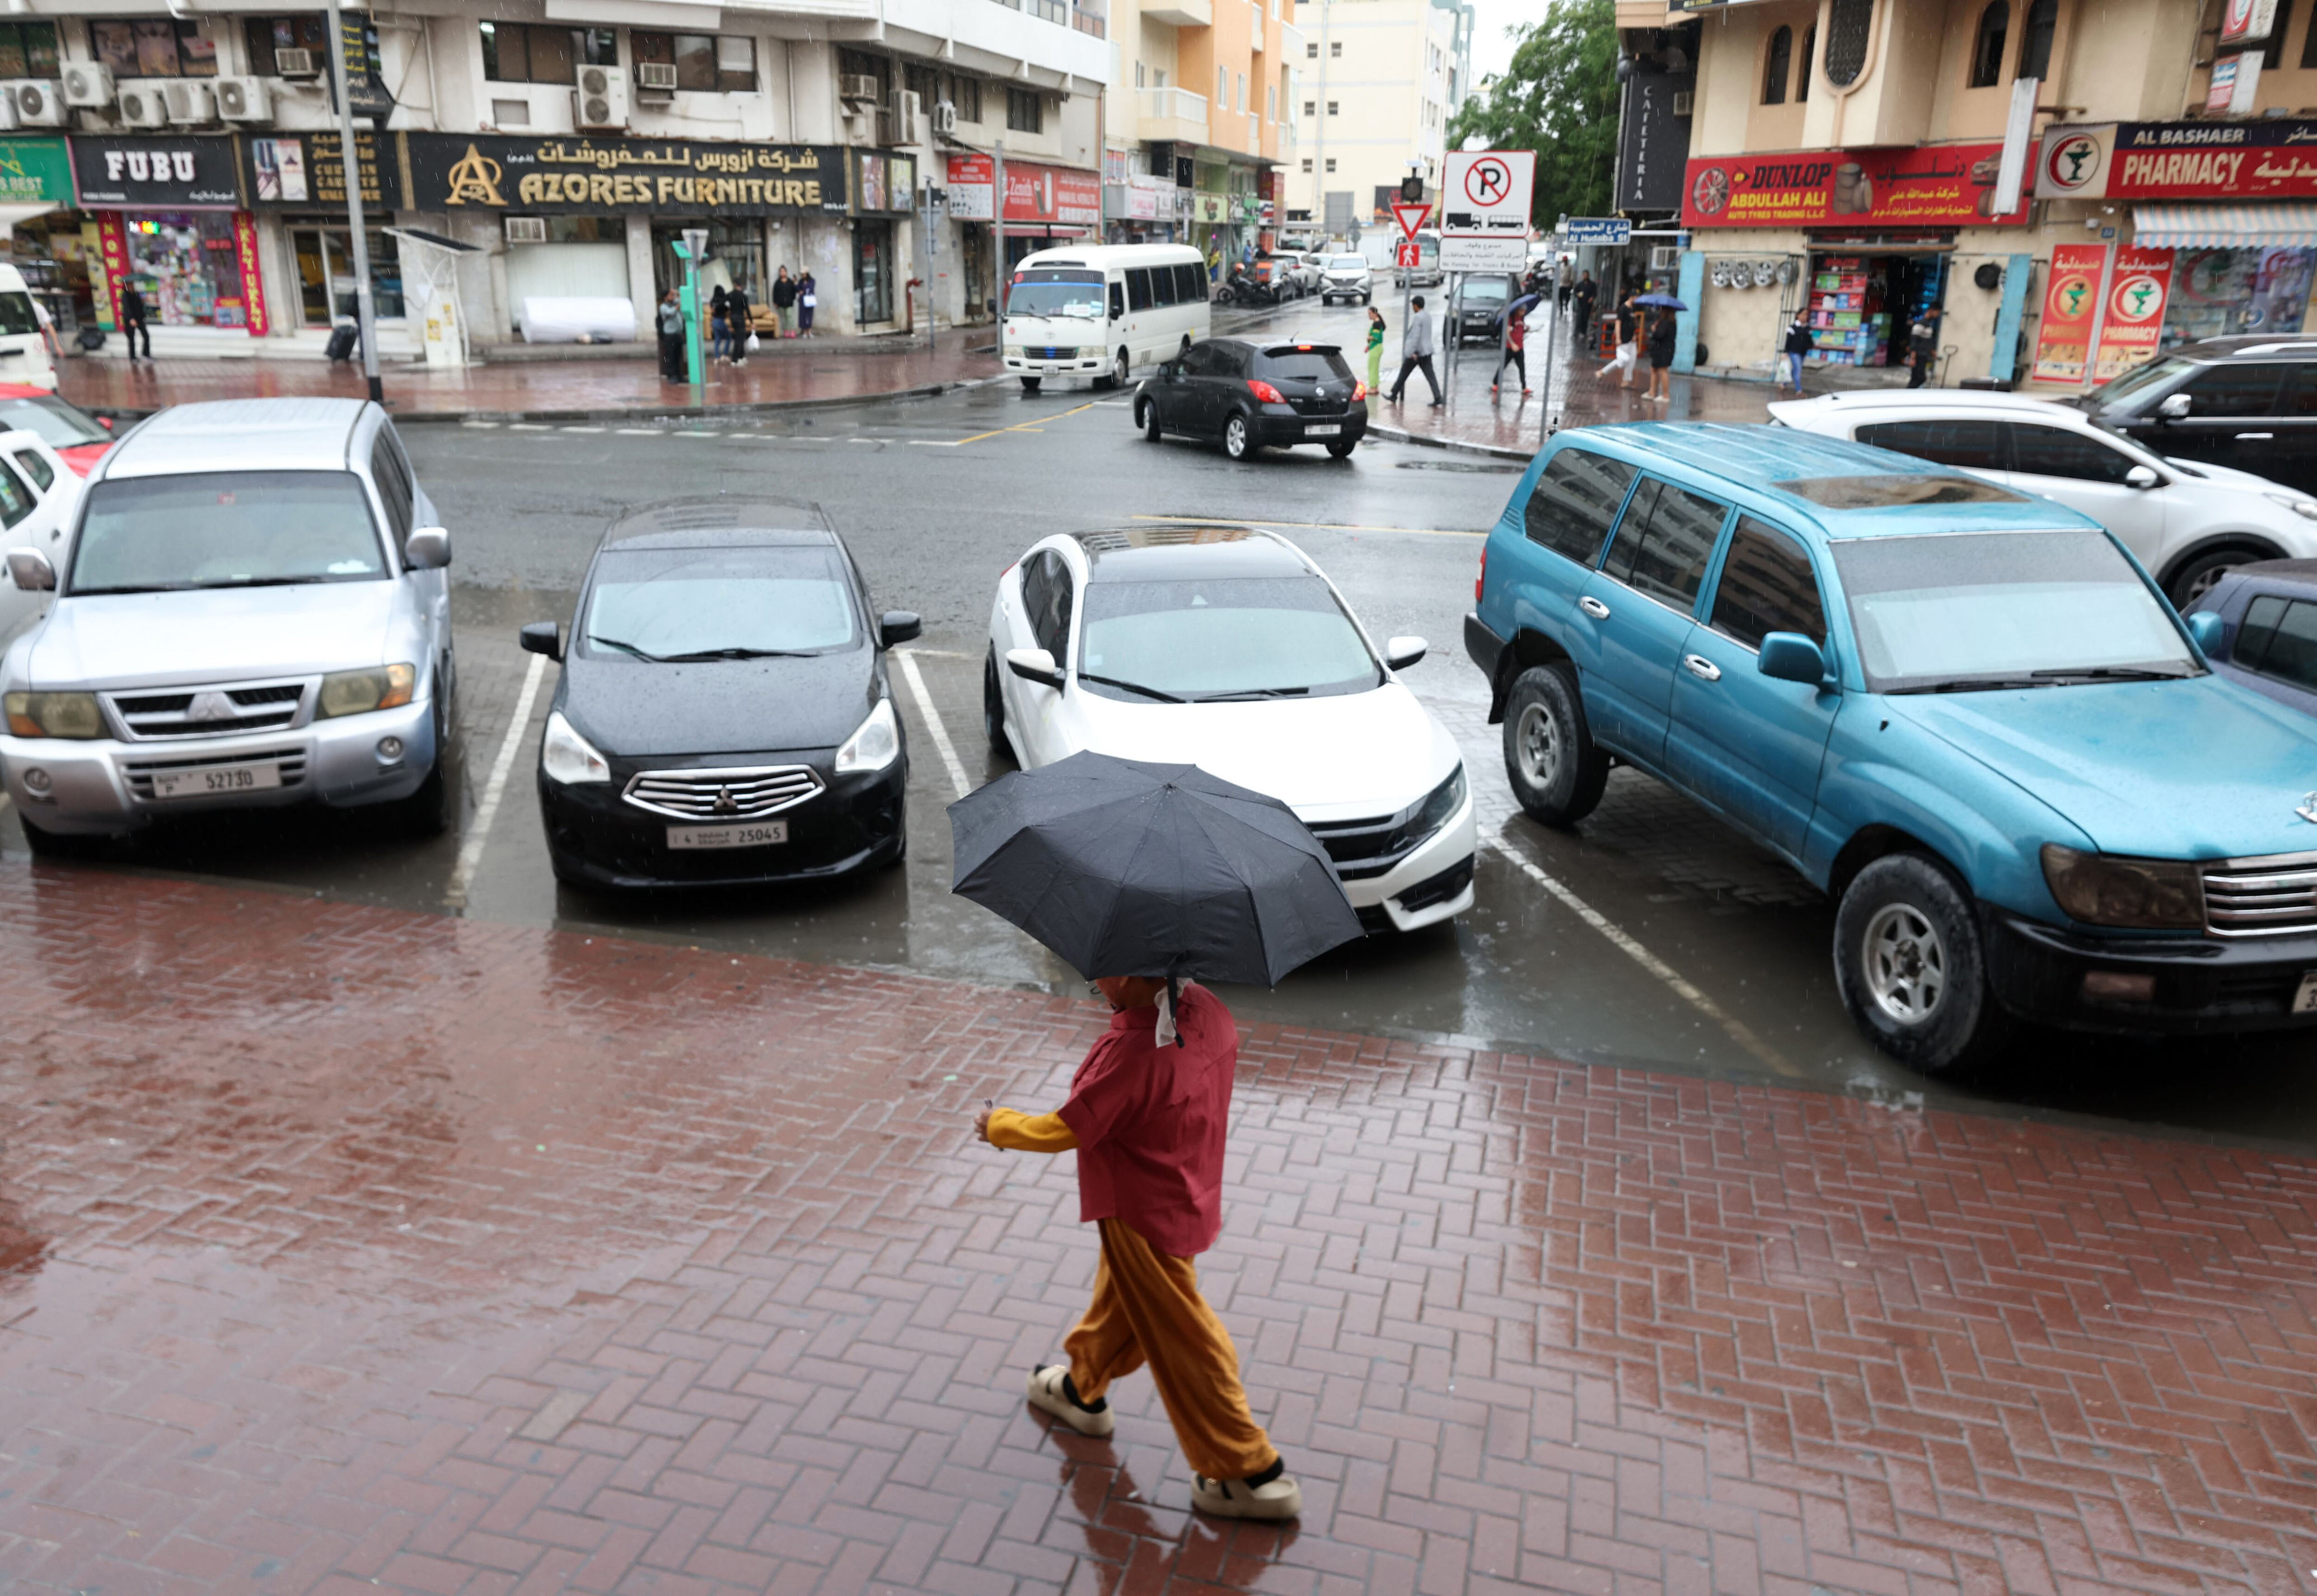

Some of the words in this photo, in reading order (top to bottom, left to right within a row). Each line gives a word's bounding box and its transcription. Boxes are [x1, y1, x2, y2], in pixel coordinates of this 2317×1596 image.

[1633, 86, 1653, 201] CAFETERIA
[2133, 129, 2157, 146] AL
[2159, 128, 2246, 145] BASHAER
[537, 139, 691, 170] للمفروشات
[695, 148, 753, 173] ازورس
[757, 147, 818, 174] شركة
[105, 151, 195, 181] FUBU
[1750, 163, 1833, 188] DUNLOP
[1876, 155, 1967, 188] دنلوب
[2121, 152, 2245, 185] PHARMACY
[519, 173, 653, 206] AZORES
[656, 176, 822, 207] FURNITURE
[1009, 176, 1033, 196] Zenith
[1480, 168, 1501, 196] P
[1729, 193, 1801, 208] ABDULLAH
[1803, 191, 1827, 207] ALI
[1936, 185, 1960, 200] شركة
[1727, 210, 1747, 219] AUTO
[1748, 210, 1771, 219] TYRES
[1772, 209, 1805, 219] TRADING
[1569, 233, 1578, 242] Al
[1580, 233, 1614, 242] Hudaiba
[1606, 222, 1628, 235] شارع
[2054, 254, 2100, 274] صيدلية
[2116, 255, 2170, 275] صيدلية
[2103, 326, 2158, 341] PHARMACY
[205, 769, 254, 790] 52730
[738, 827, 780, 843] 25045
